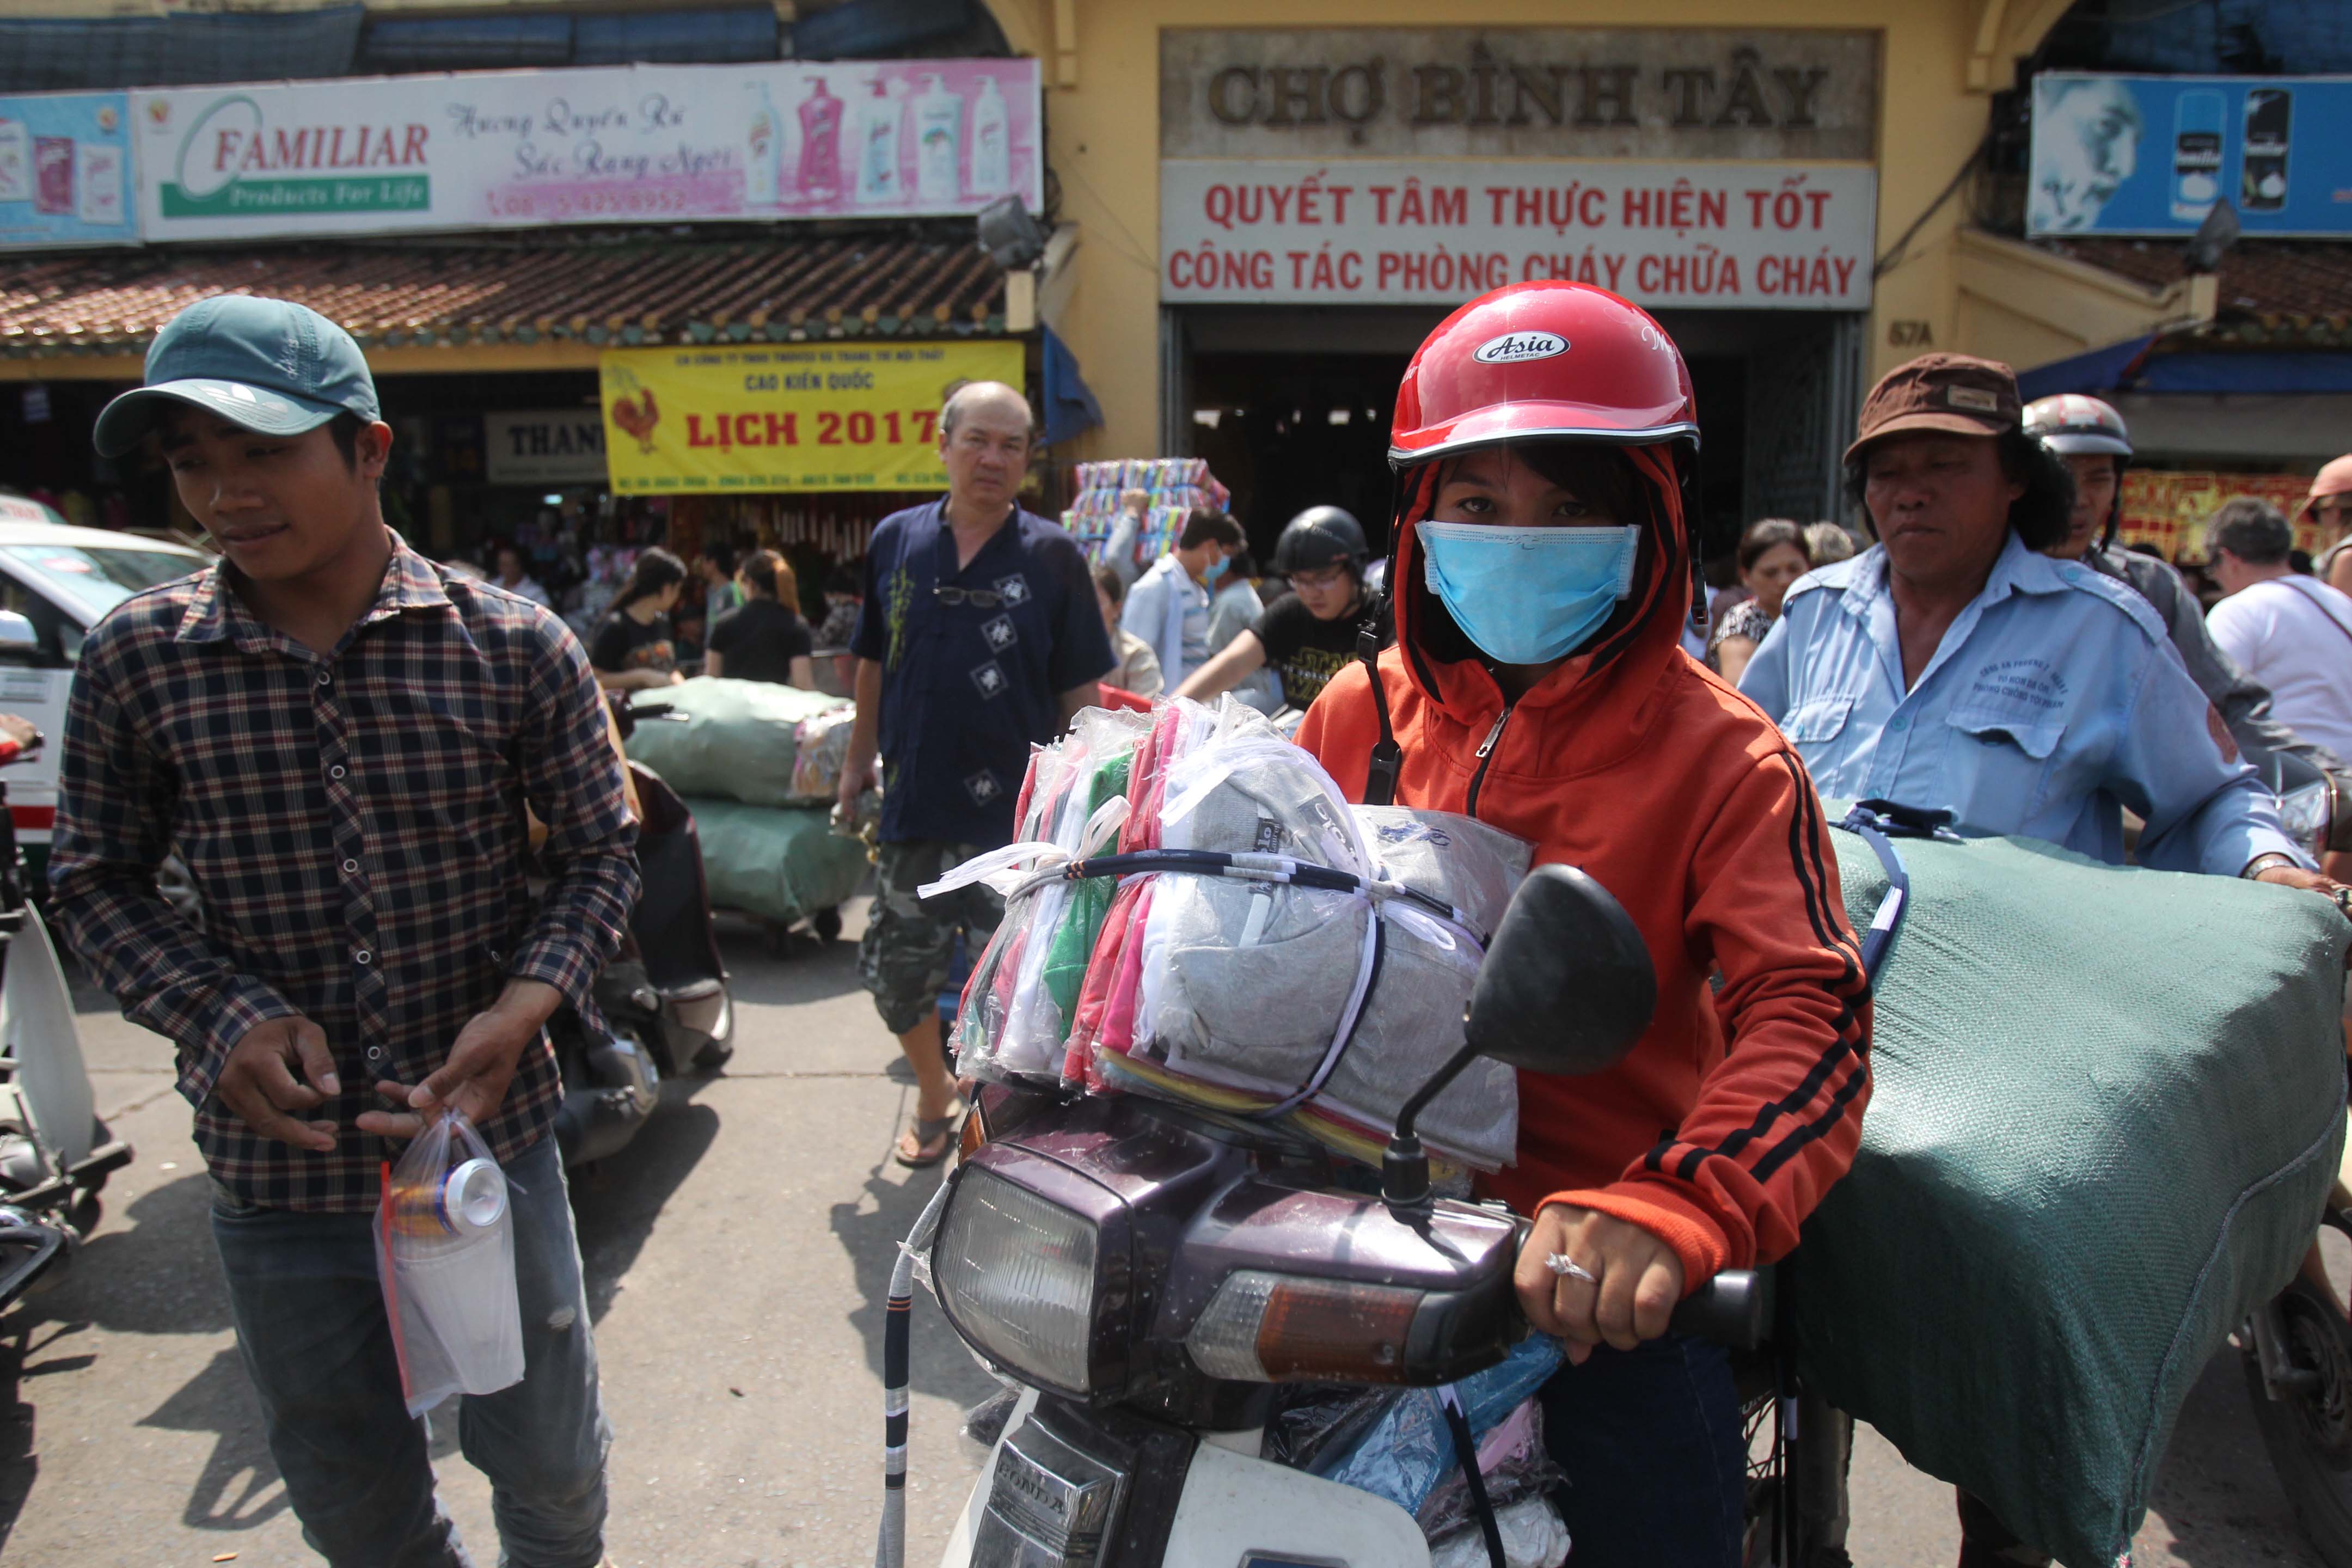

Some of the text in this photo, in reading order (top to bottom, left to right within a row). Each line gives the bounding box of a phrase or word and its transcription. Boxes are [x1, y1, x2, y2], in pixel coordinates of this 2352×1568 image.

[1208, 38, 1828, 148] CHỢ BÌNH TÂY
[213, 123, 429, 172] FAMILIAR
[229, 180, 423, 207] Products For Life
[1204, 169, 1832, 237] QUYẾT TÂM THỰC HIỆN TỐT
[1168, 240, 1857, 297] CÔNG TÁC PHÒNG CHÁY CHỮA CHÁY
[1486, 336, 1555, 359] Asia
[1500, 352, 1541, 361] HELMETAC
[744, 373, 779, 391] CAO
[827, 367, 874, 390] QUỐC
[686, 409, 939, 454] LỊCH 2017
[997, 1461, 1065, 1515] HONDA
